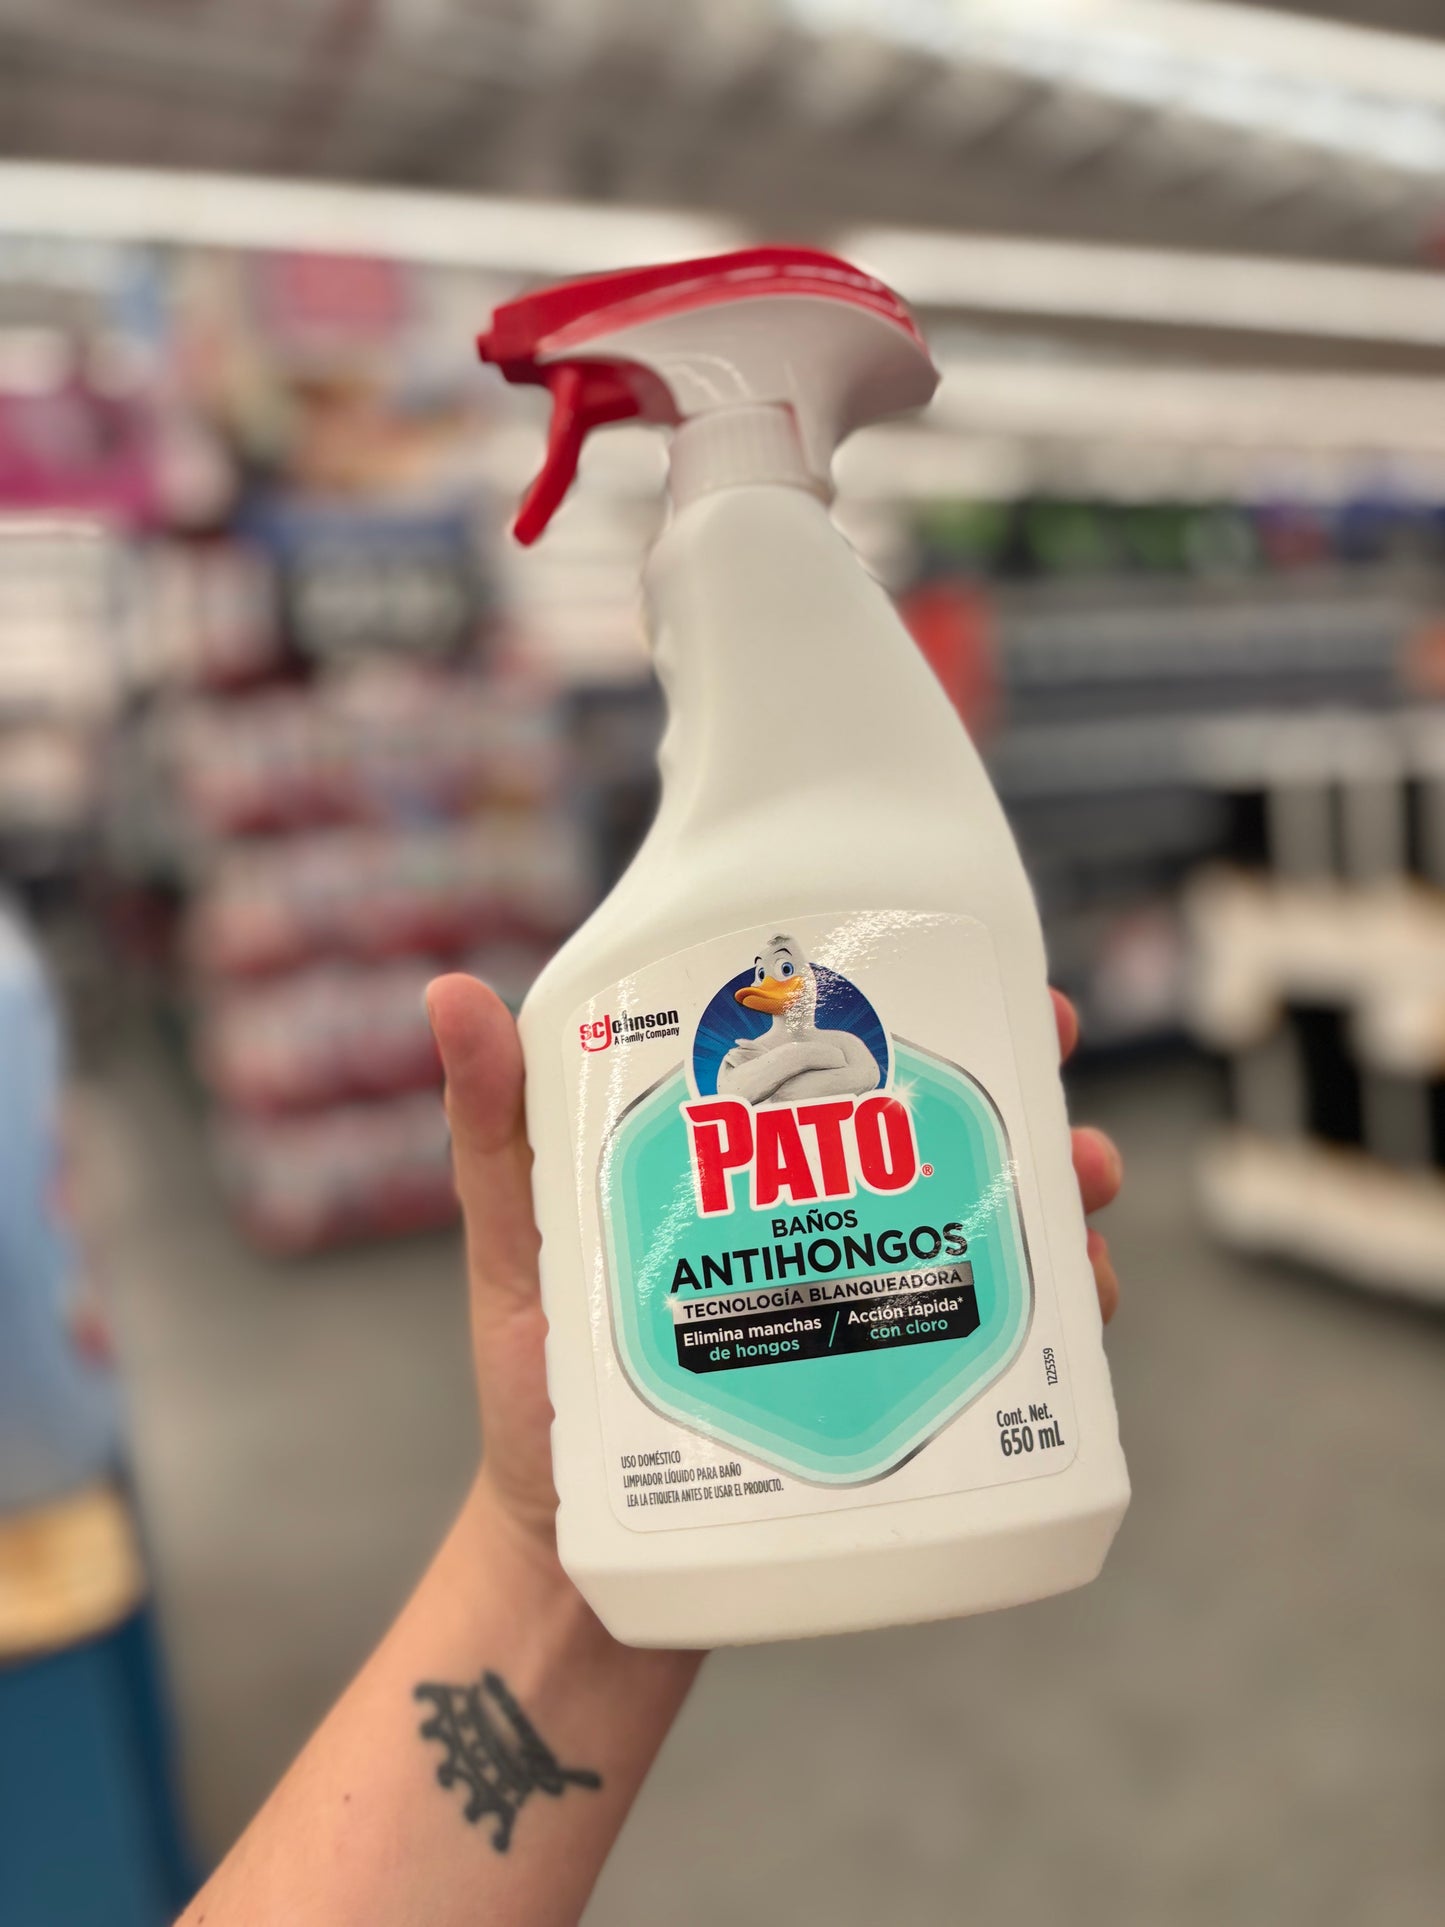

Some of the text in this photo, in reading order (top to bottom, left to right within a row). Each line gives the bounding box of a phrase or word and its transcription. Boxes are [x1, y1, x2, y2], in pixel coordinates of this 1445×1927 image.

[614, 1026, 680, 1046] A Family Company
[686, 1097, 916, 1213] PATO
[771, 1209, 858, 1239] BAÑOS
[670, 1222, 968, 1294] ANTIHONGOS
[683, 1269, 963, 1319] TECNOLOGÍA BLANQUEADORA
[848, 1305, 903, 1325] Acción
[870, 1319, 948, 1340] con cloro
[683, 1316, 822, 1347] Elimina manchas
[709, 1337, 800, 1361] de hongos
[1043, 1347, 1058, 1386] 1225359
[996, 1403, 1053, 1427] Cont. Net.
[1000, 1420, 1065, 1456] 650 mL
[621, 1450, 681, 1469] USO DOMÉSTICO
[623, 1462, 742, 1488] LIMPIADOR LÍQUIDO PARA BAÑO
[627, 1478, 784, 1507] LEA LA ETIQUETA ANTES DE USAR EL PRODUCTO.
